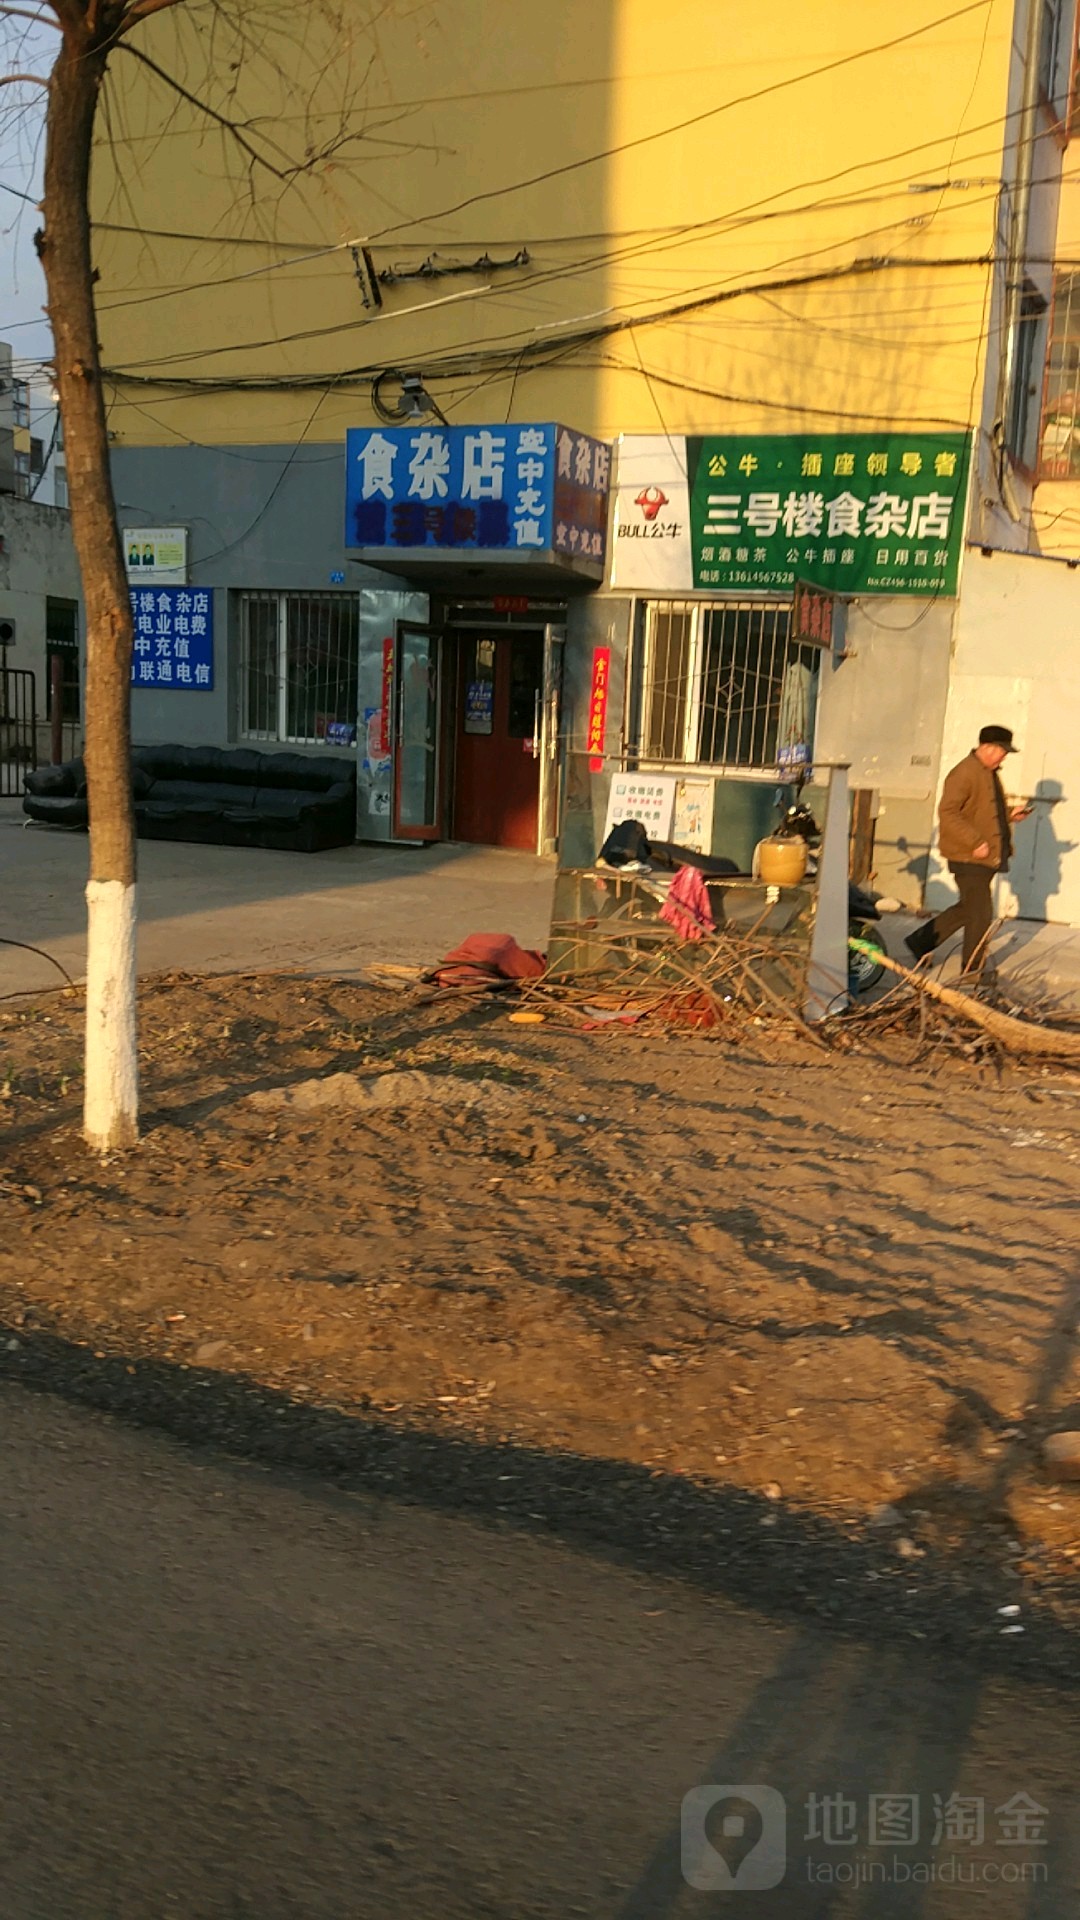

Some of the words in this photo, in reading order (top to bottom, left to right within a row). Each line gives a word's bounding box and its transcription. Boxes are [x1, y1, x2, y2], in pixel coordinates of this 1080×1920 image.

[357, 430, 506, 500] 食杂店
[514, 428, 548, 547] 空中充值
[557, 430, 610, 493] 食杂店
[703, 490, 954, 540] 三号楼食杂店
[786, 547, 856, 565] 公牛插座
[876, 548, 949, 567] 日用百货
